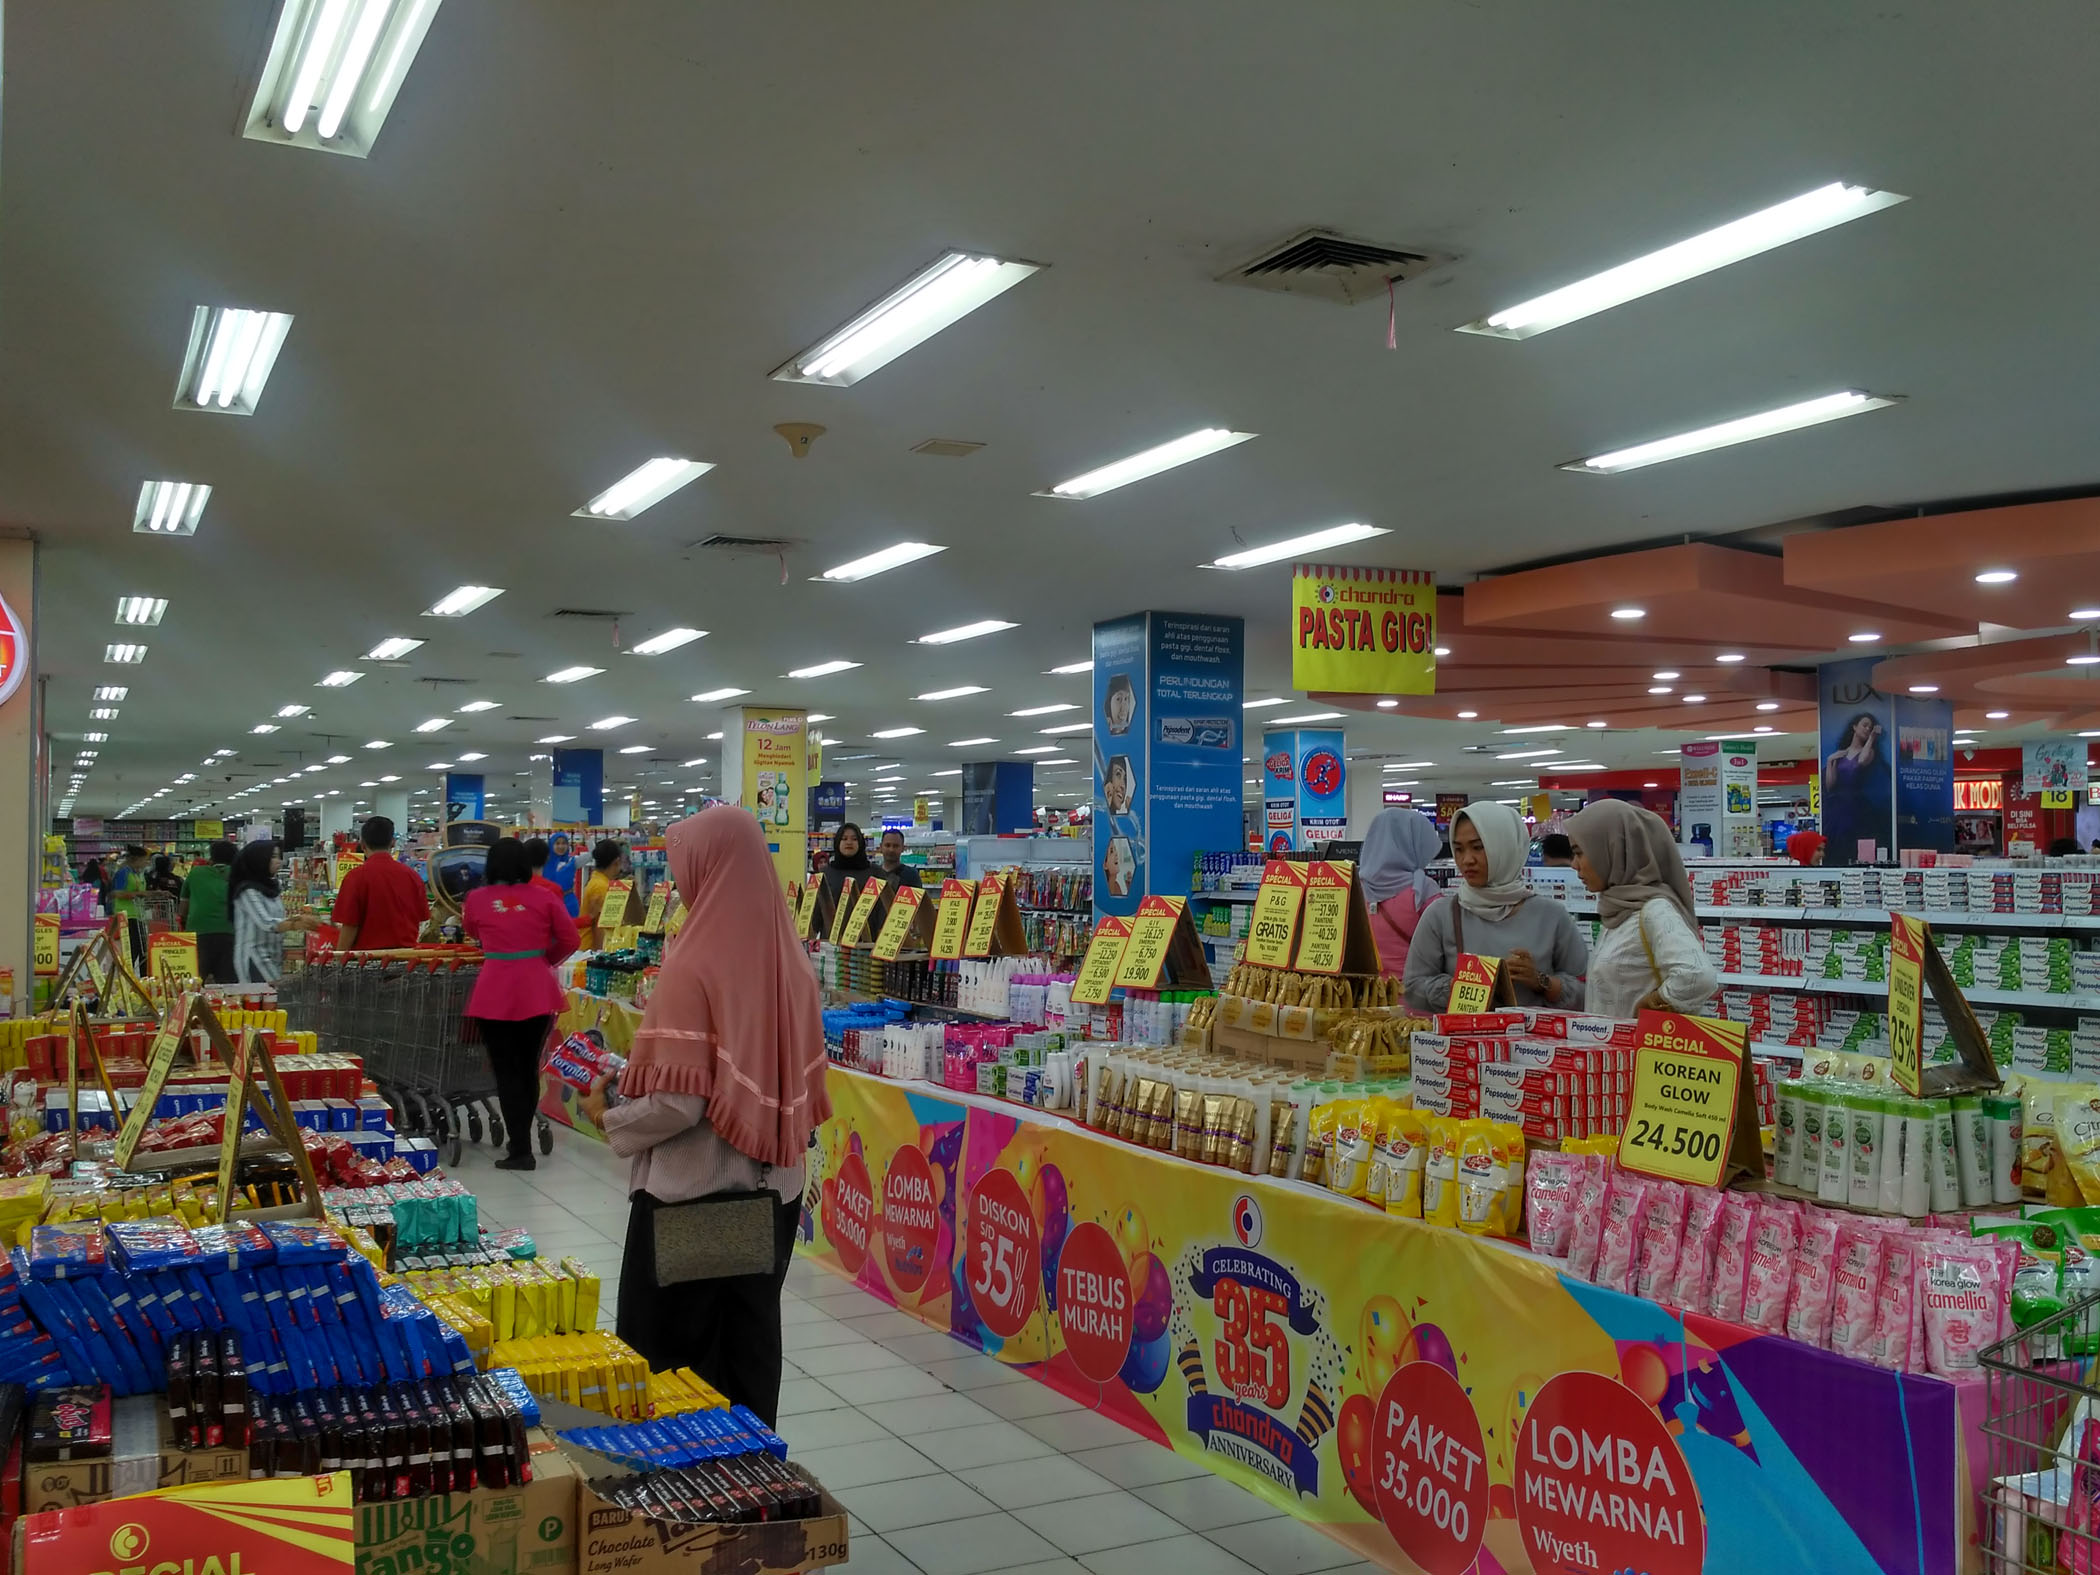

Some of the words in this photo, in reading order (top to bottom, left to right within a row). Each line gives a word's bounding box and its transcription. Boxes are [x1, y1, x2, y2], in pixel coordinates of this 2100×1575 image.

[1340, 587, 1415, 605] chandra
[1191, 635, 1229, 644] penggunaan
[1299, 607, 1376, 652] PASTA
[1161, 642, 1180, 650] pasta
[1171, 653, 1183, 661] dan
[1160, 676, 1230, 689] PERLINDUNGAN
[1157, 689, 1182, 699] TOTAL
[1183, 690, 1233, 701] TERLENGKAP
[757, 739, 772, 750] 12
[1268, 812, 1292, 820] GELIGA
[2019, 810, 2033, 818] SINI
[1306, 829, 1344, 839] GELIGA
[1265, 875, 1292, 885] SPECIAL
[1309, 877, 1335, 886] SPECIAL
[1270, 895, 1287, 907] P&G
[1140, 908, 1166, 916] SPECIAL
[1097, 928, 1120, 936] SPECIAL
[1255, 921, 1289, 940] GRATIS
[1311, 942, 1331, 950] PANTENE
[1123, 966, 1150, 980] 19.900
[1458, 970, 1482, 983] SPECIAL
[1459, 986, 1478, 1000] BELI
[1479, 988, 1486, 1001] 3
[1644, 1033, 1708, 1054] SPECIAL
[1892, 1016, 1916, 1072] 25%
[1654, 1061, 1721, 1085] KOREAN
[1660, 1084, 1710, 1105] GLOW
[1644, 1102, 1657, 1111] Body
[1658, 1105, 1673, 1114] Wash
[1708, 1113, 1718, 1122] 450
[1630, 1119, 1721, 1162] 24.500
[838, 1178, 872, 1220] PAKET
[887, 1174, 933, 1205] LOMBA
[1531, 1187, 1570, 1203] camellia
[884, 1206, 935, 1230] MEWARNAI
[979, 1194, 1030, 1240] DISKON
[836, 1207, 866, 1250] 35.000
[980, 1221, 996, 1242] S/D
[975, 1234, 1030, 1320] 35%
[1212, 1259, 1292, 1299] CELEBRATING
[1930, 1278, 1956, 1289] korea
[1957, 1280, 1981, 1290] glow
[1063, 1268, 1126, 1310] TEBUS
[1927, 1292, 1988, 1311] camellia
[1064, 1303, 1123, 1343] MURAH
[1214, 1277, 1291, 1410] 35
[1234, 1382, 1269, 1405] years
[1212, 1402, 1294, 1464] chandra
[1386, 1400, 1482, 1492] PAKET
[1209, 1434, 1295, 1490] ANNIVERSARY
[1530, 1418, 1676, 1496] LOMBA
[1379, 1451, 1469, 1543] 35.000
[1524, 1470, 1685, 1545] MEWARNAI
[592, 1511, 631, 1526] BARU!
[588, 1535, 655, 1556] Chocolate
[1532, 1525, 1600, 1569] Wyeth
[588, 1558, 612, 1573] Long
[614, 1556, 644, 1571] Wafer
